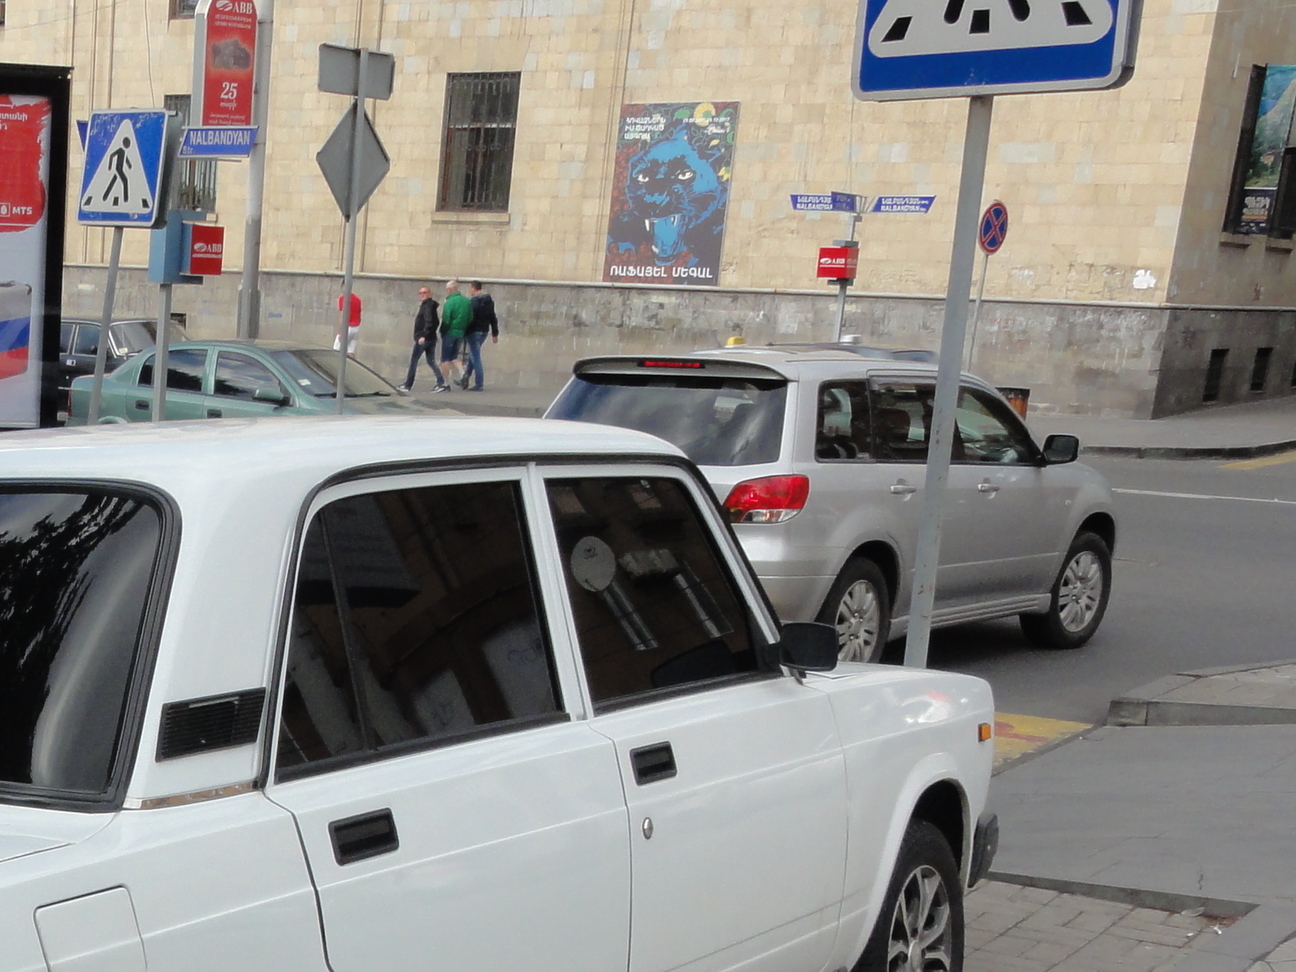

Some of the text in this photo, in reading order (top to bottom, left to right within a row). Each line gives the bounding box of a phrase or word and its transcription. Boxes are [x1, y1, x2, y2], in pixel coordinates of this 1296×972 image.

[232, 1, 253, 14] ABB
[220, 82, 238, 99] 25
[189, 130, 251, 146] NALBANDYAN
[12, 206, 33, 215] MTS
[206, 243, 222, 253] ABB
